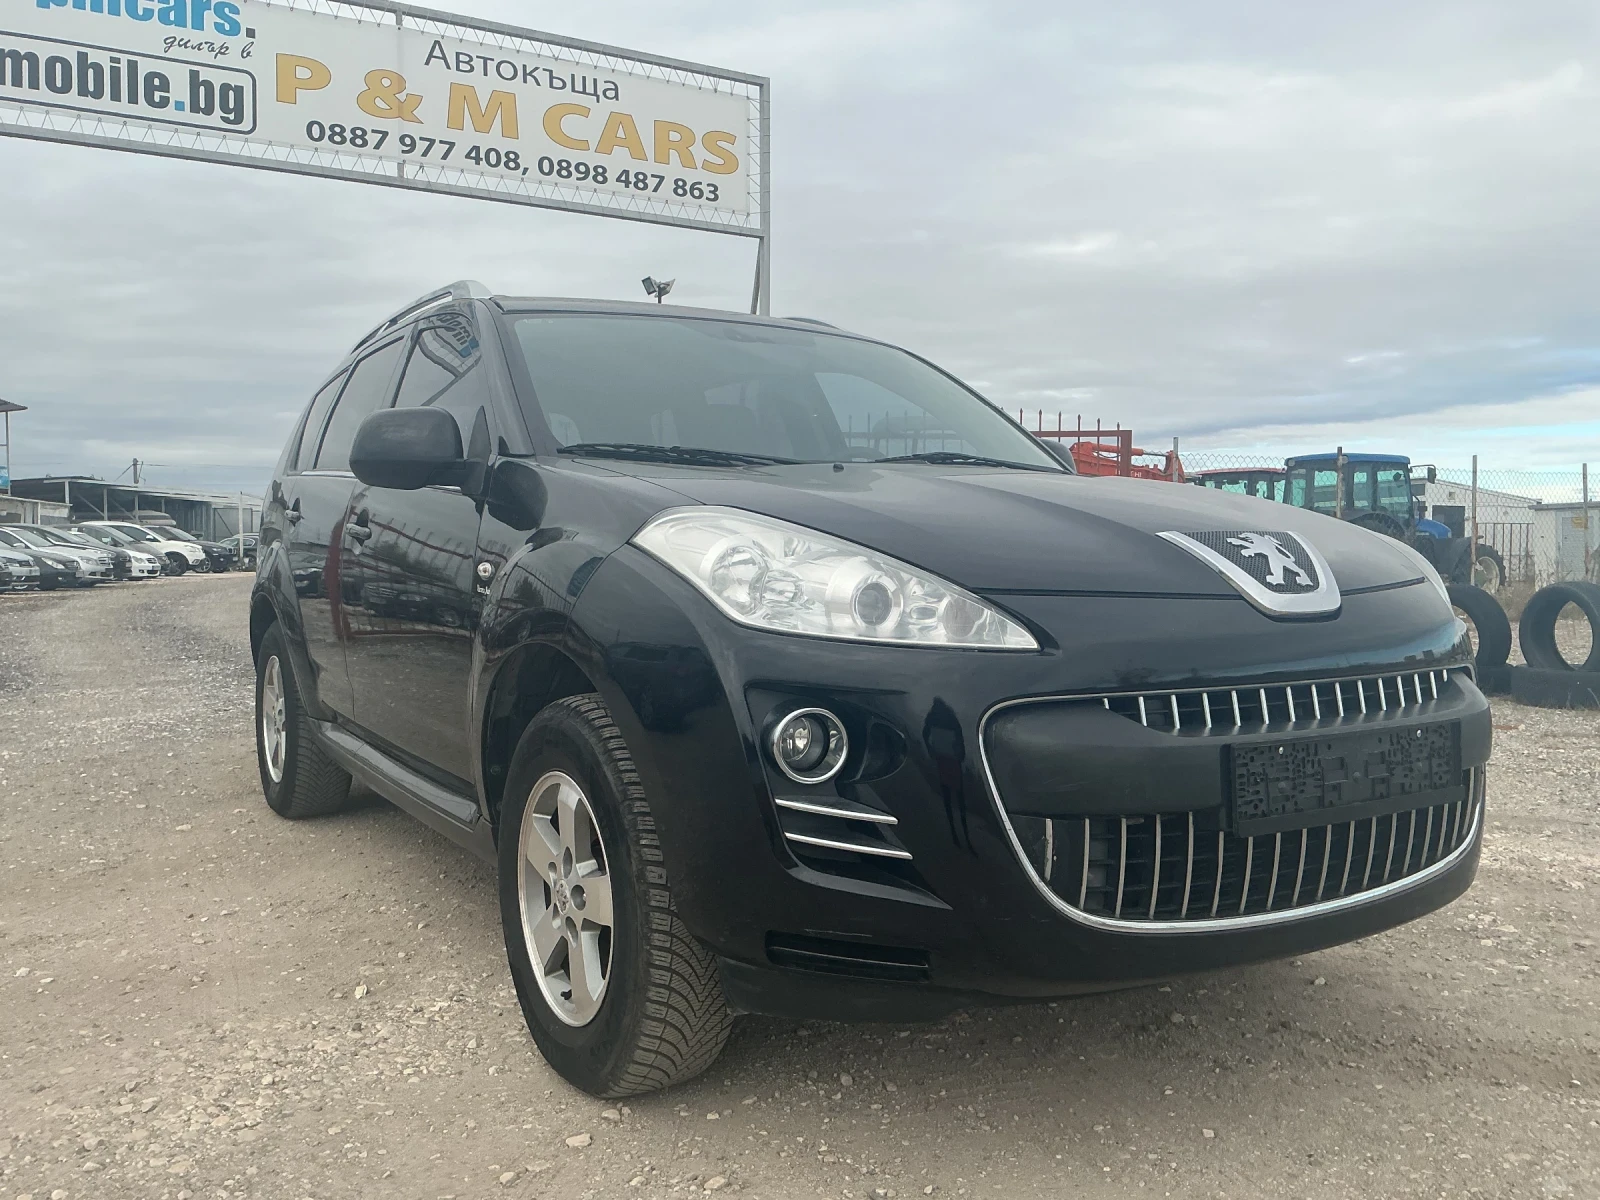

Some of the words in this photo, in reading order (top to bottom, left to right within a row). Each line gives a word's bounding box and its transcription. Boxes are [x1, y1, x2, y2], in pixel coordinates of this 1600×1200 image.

[163, 35, 230, 60] дилър
[240, 41, 255, 59] в
[424, 39, 620, 103] Автокъща
[0, 48, 245, 125] mobile.bg
[275, 52, 332, 105] P
[356, 69, 425, 125] &
[446, 81, 519, 140] M
[542, 102, 740, 175] CARS
[305, 120, 390, 151] 0887
[398, 133, 456, 161] 977
[464, 145, 530, 176] 408,
[537, 155, 609, 185] 0898
[615, 169, 666, 193] 487
[672, 177, 720, 203] 863
